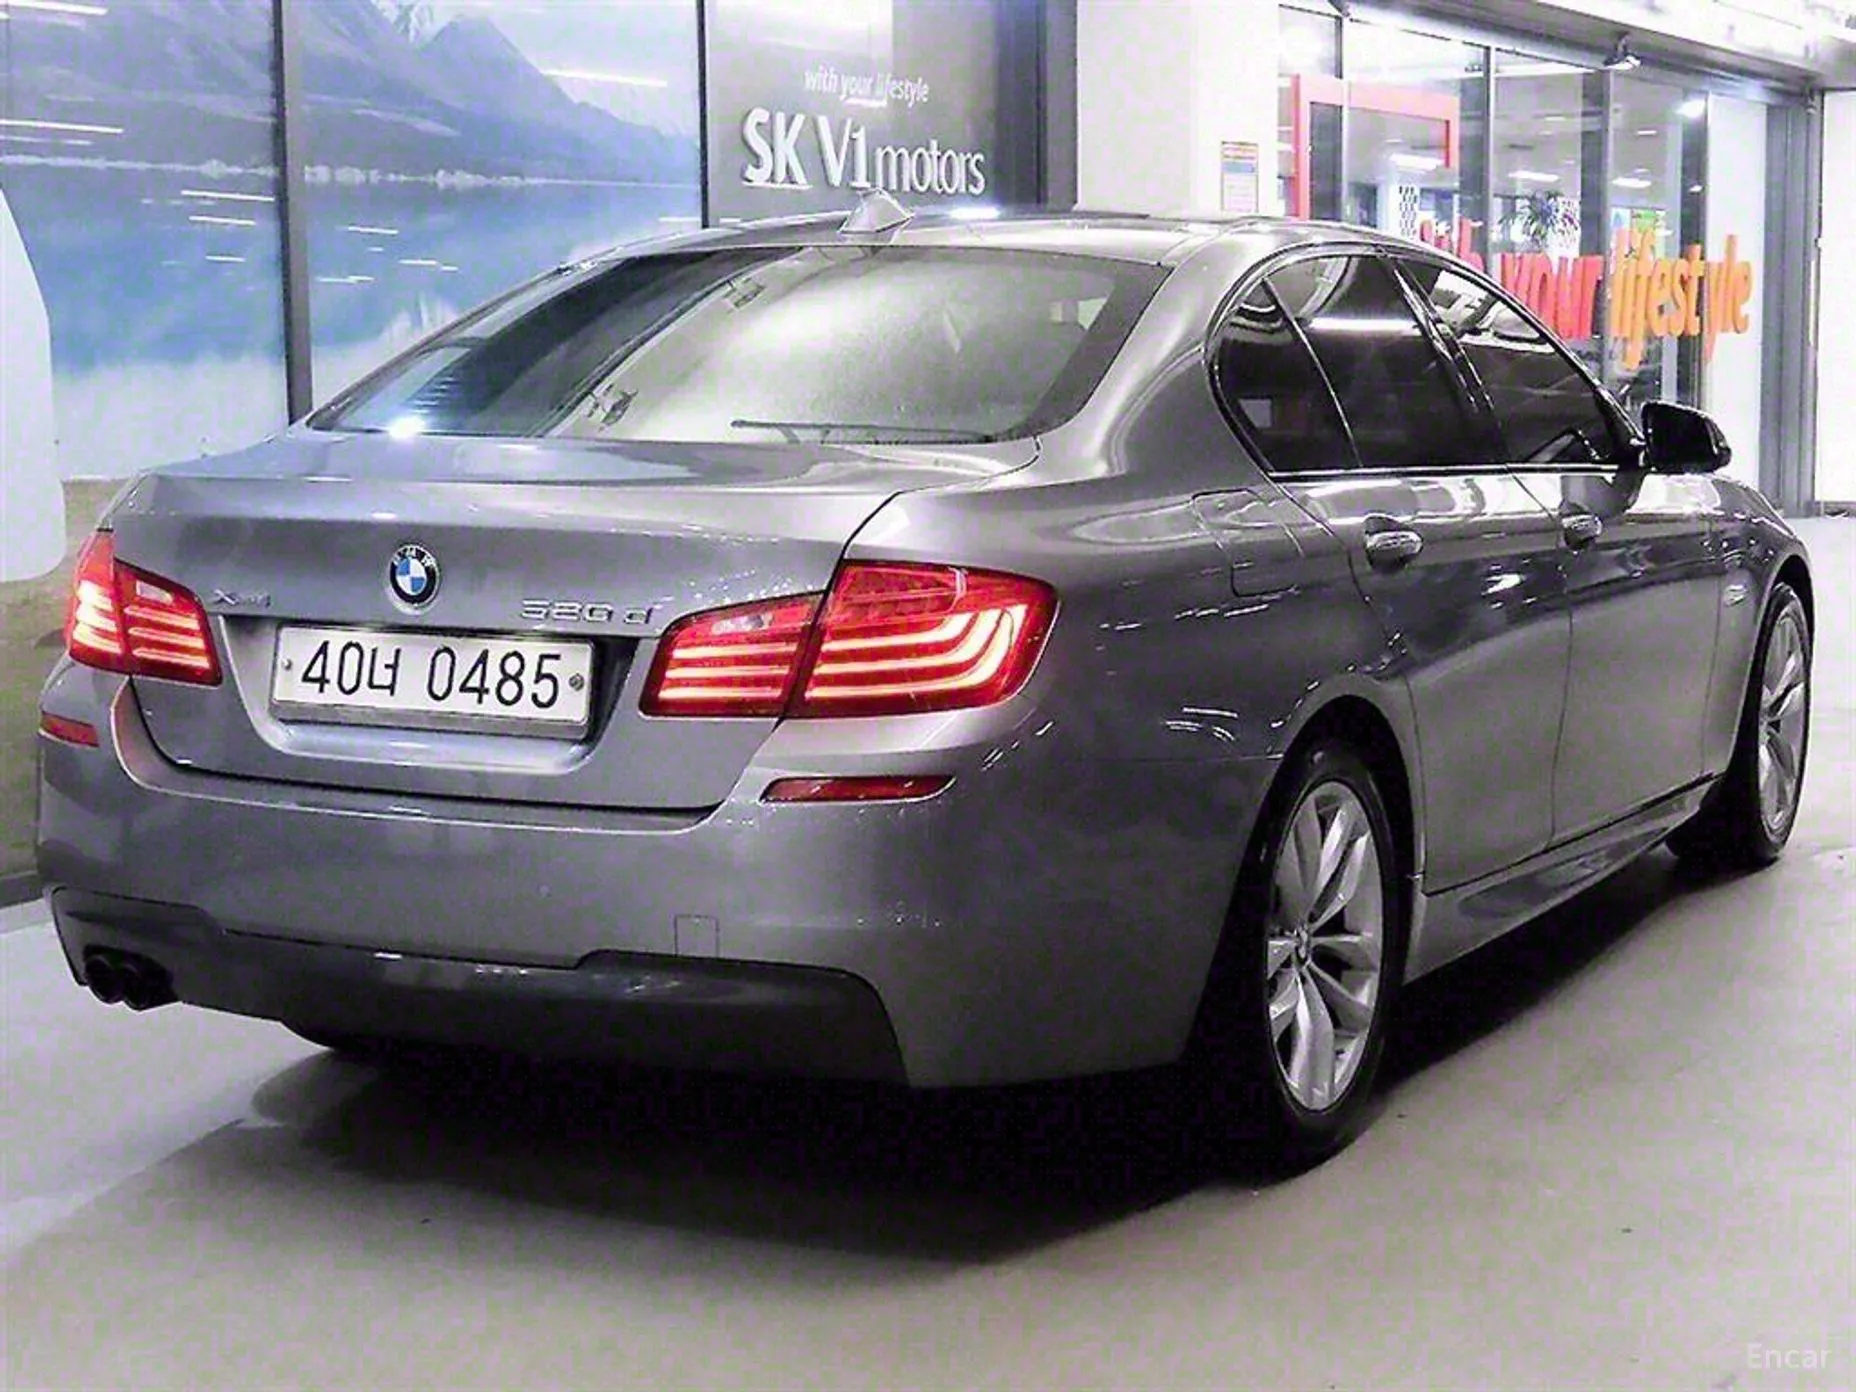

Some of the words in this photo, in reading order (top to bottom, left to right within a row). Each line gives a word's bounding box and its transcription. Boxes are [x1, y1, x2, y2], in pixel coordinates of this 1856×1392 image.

[804, 64, 839, 93] with
[839, 74, 874, 102] your
[875, 73, 930, 108] lifestyle
[743, 107, 810, 186] SK
[874, 139, 986, 194] motors
[1611, 228, 1753, 370] lifestyle
[301, 640, 402, 696] 40너
[427, 645, 562, 708] 0485
